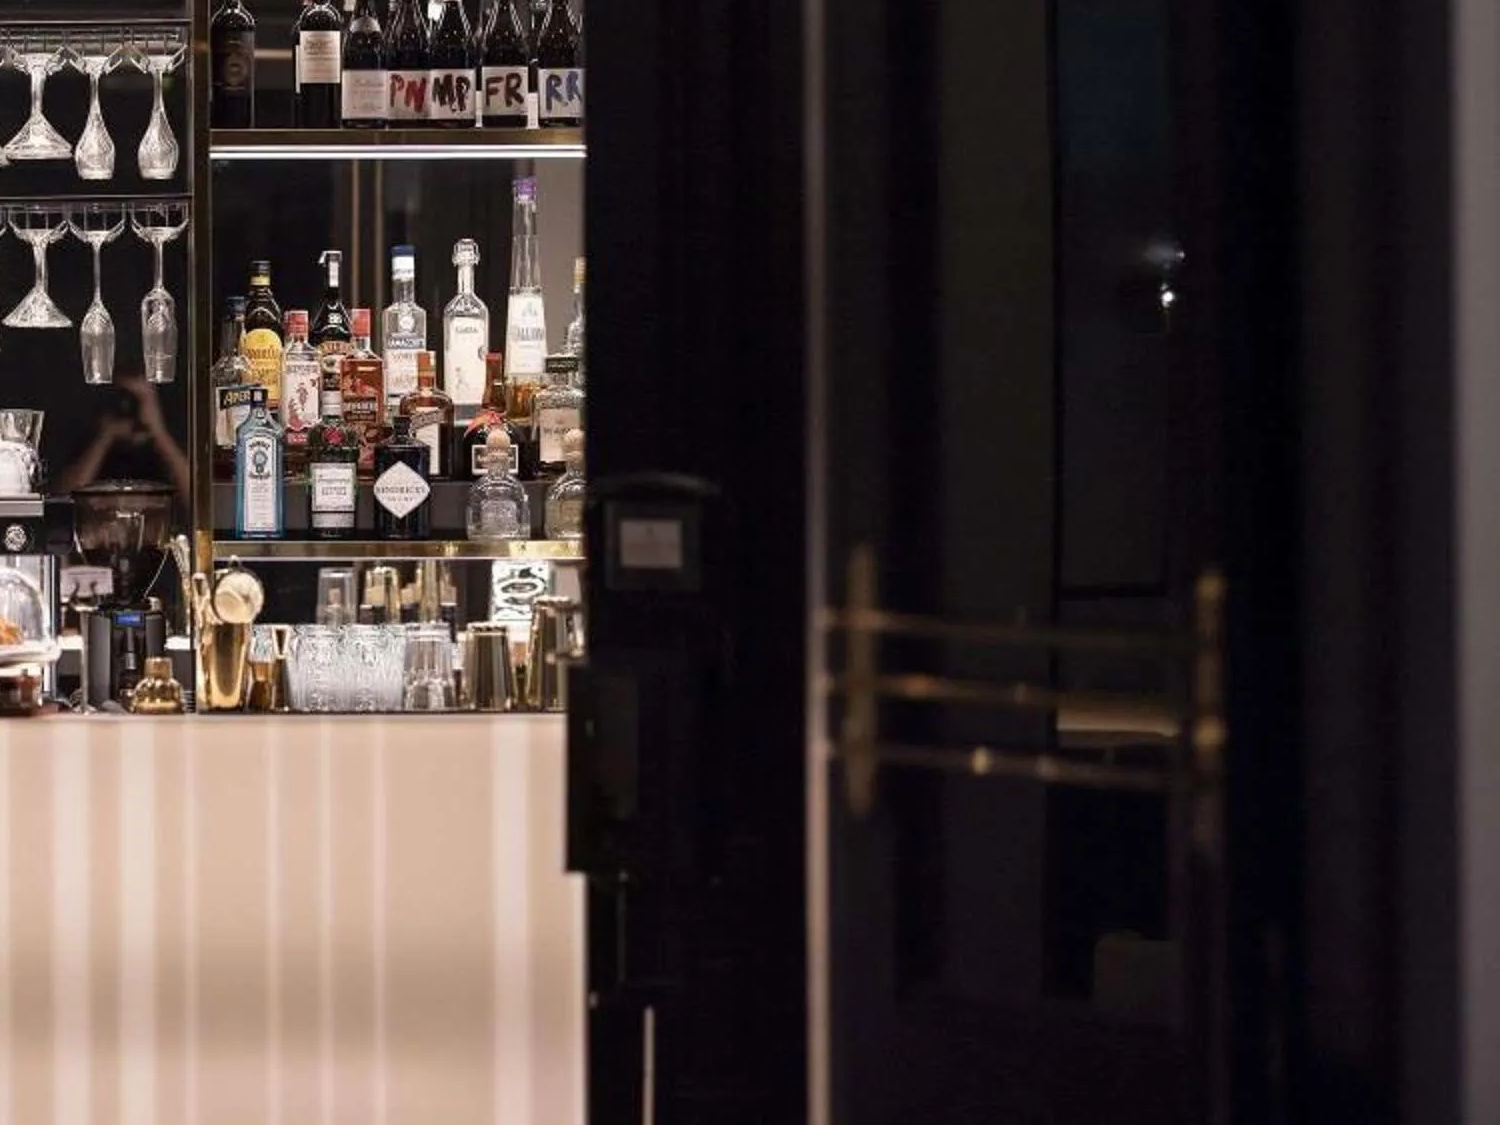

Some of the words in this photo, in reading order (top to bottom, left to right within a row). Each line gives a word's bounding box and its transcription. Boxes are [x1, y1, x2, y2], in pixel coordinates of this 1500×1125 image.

[389, 73, 427, 113] PN
[431, 73, 471, 112] MP
[485, 72, 525, 108] FR
